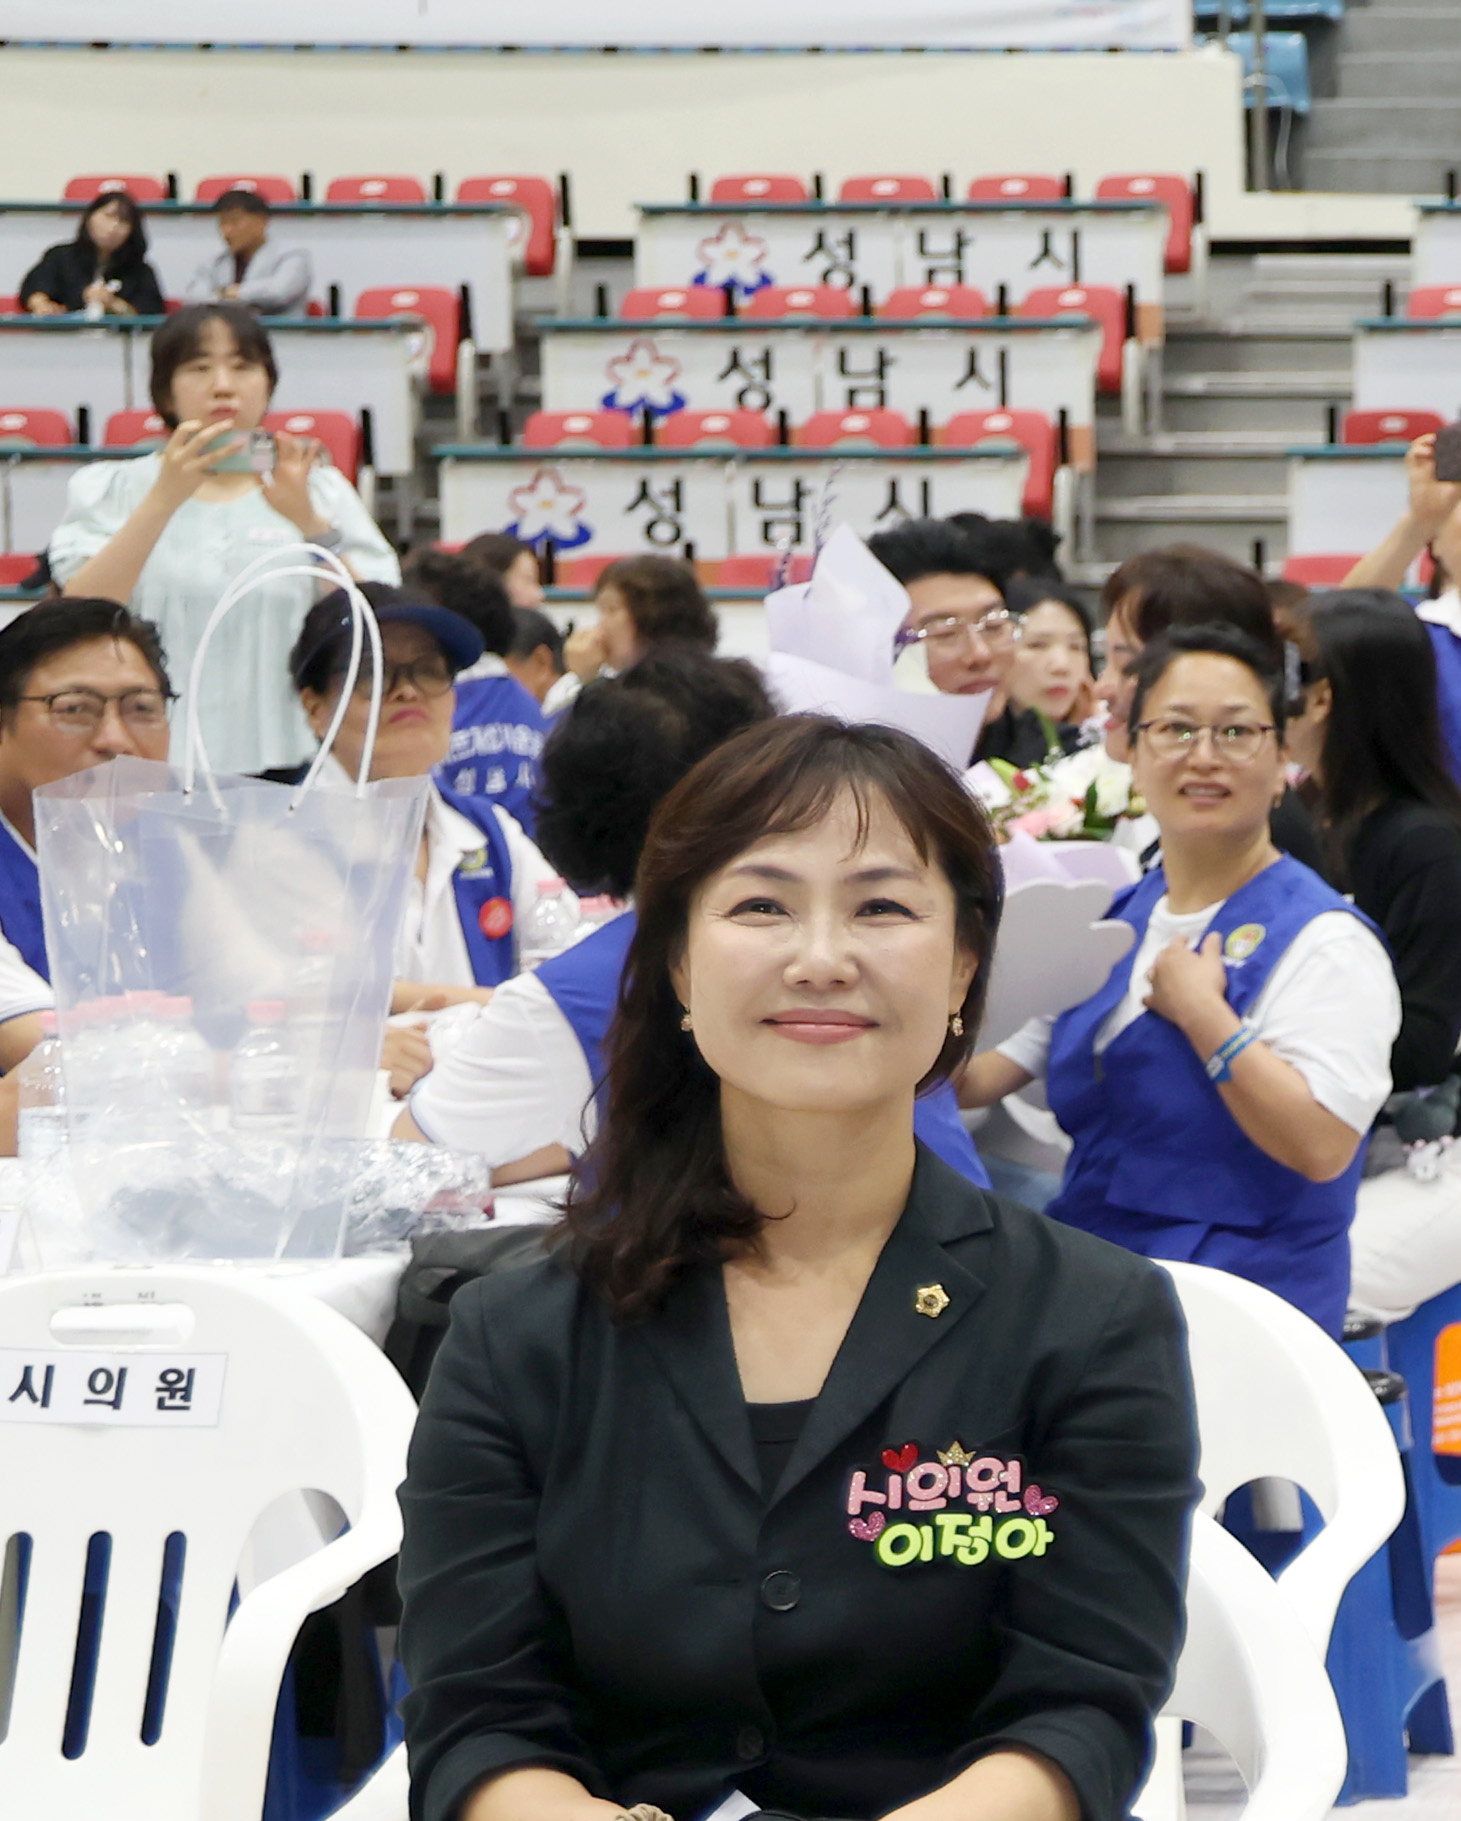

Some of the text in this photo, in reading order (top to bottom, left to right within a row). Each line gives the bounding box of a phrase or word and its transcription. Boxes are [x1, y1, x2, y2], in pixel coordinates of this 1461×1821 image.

[719, 345, 1009, 411] 성남시
[8, 1364, 197, 1411] 시의원
[847, 1456, 1024, 1515] 시의원
[877, 1512, 1056, 1567] 이정아
